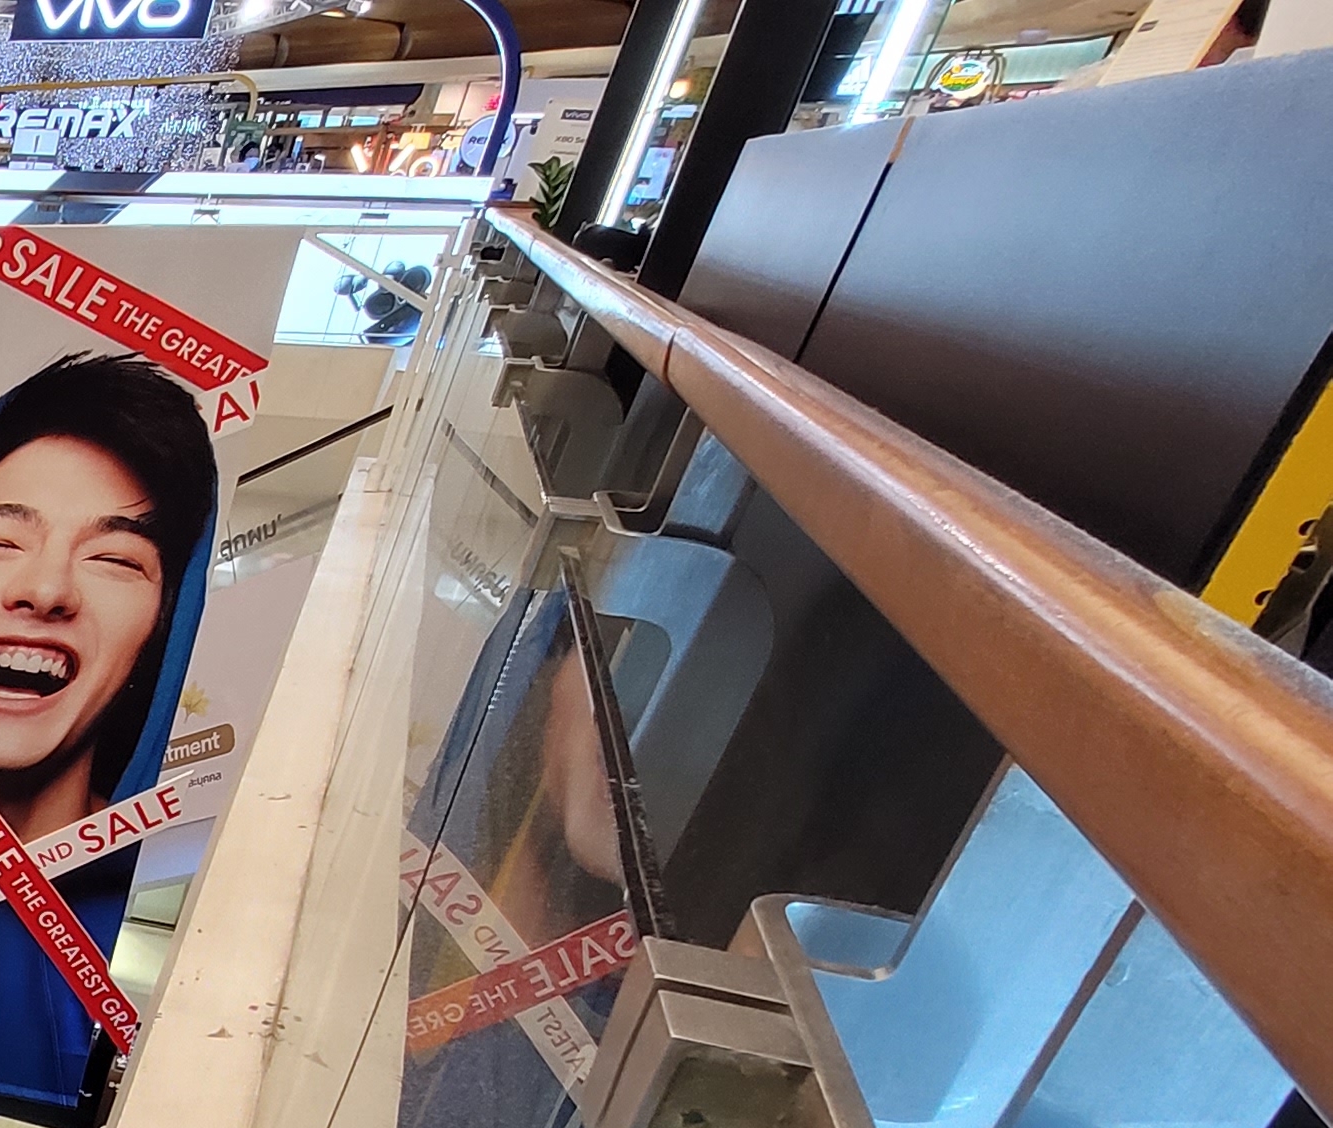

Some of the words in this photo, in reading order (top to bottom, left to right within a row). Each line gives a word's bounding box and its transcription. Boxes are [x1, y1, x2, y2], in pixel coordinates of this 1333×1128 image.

[1, 238, 118, 322] SALE
[111, 299, 163, 341] THE
[77, 786, 183, 855] SALE
[11, 871, 47, 913] THE
[38, 910, 110, 997] GREATEST
